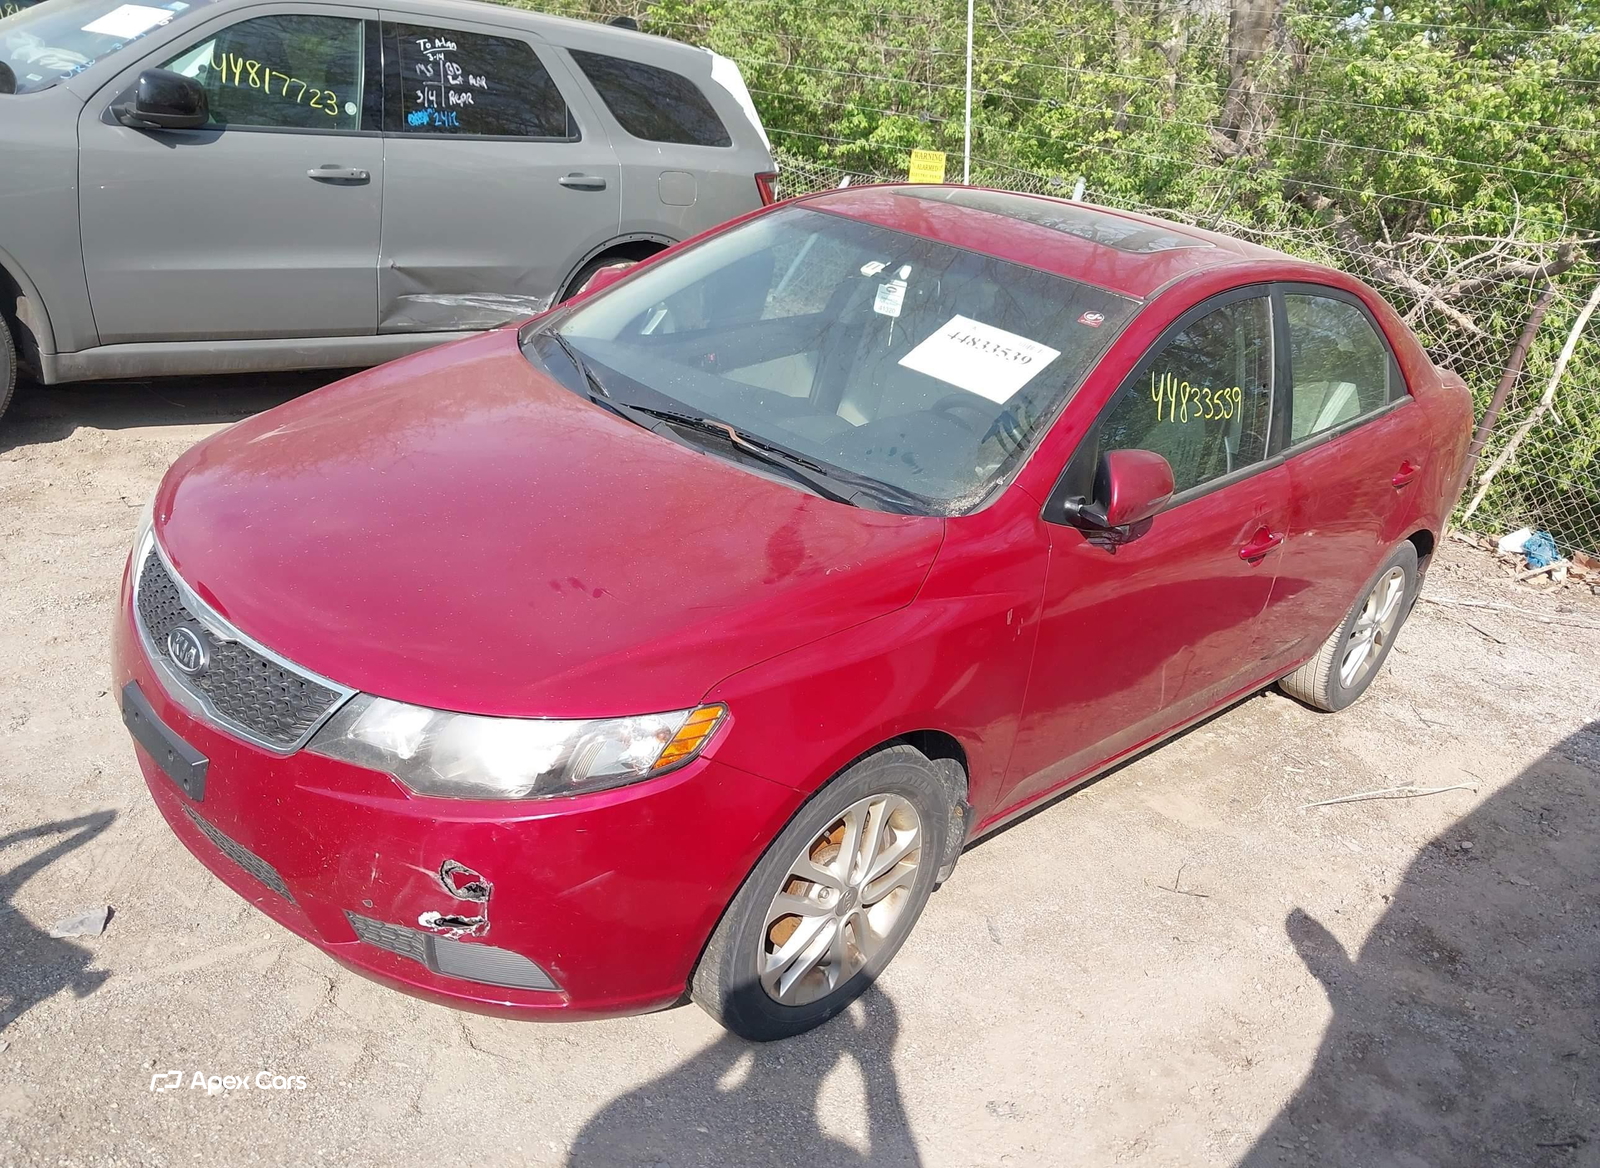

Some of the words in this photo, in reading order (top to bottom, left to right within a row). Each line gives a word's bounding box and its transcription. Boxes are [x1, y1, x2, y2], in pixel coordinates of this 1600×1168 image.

[416, 39, 431, 51] To
[211, 52, 339, 116] 44817723
[914, 151, 943, 162] WARNING
[947, 331, 1033, 365] 44833539
[1152, 370, 1242, 424] 44833539
[171, 631, 198, 669] KIA
